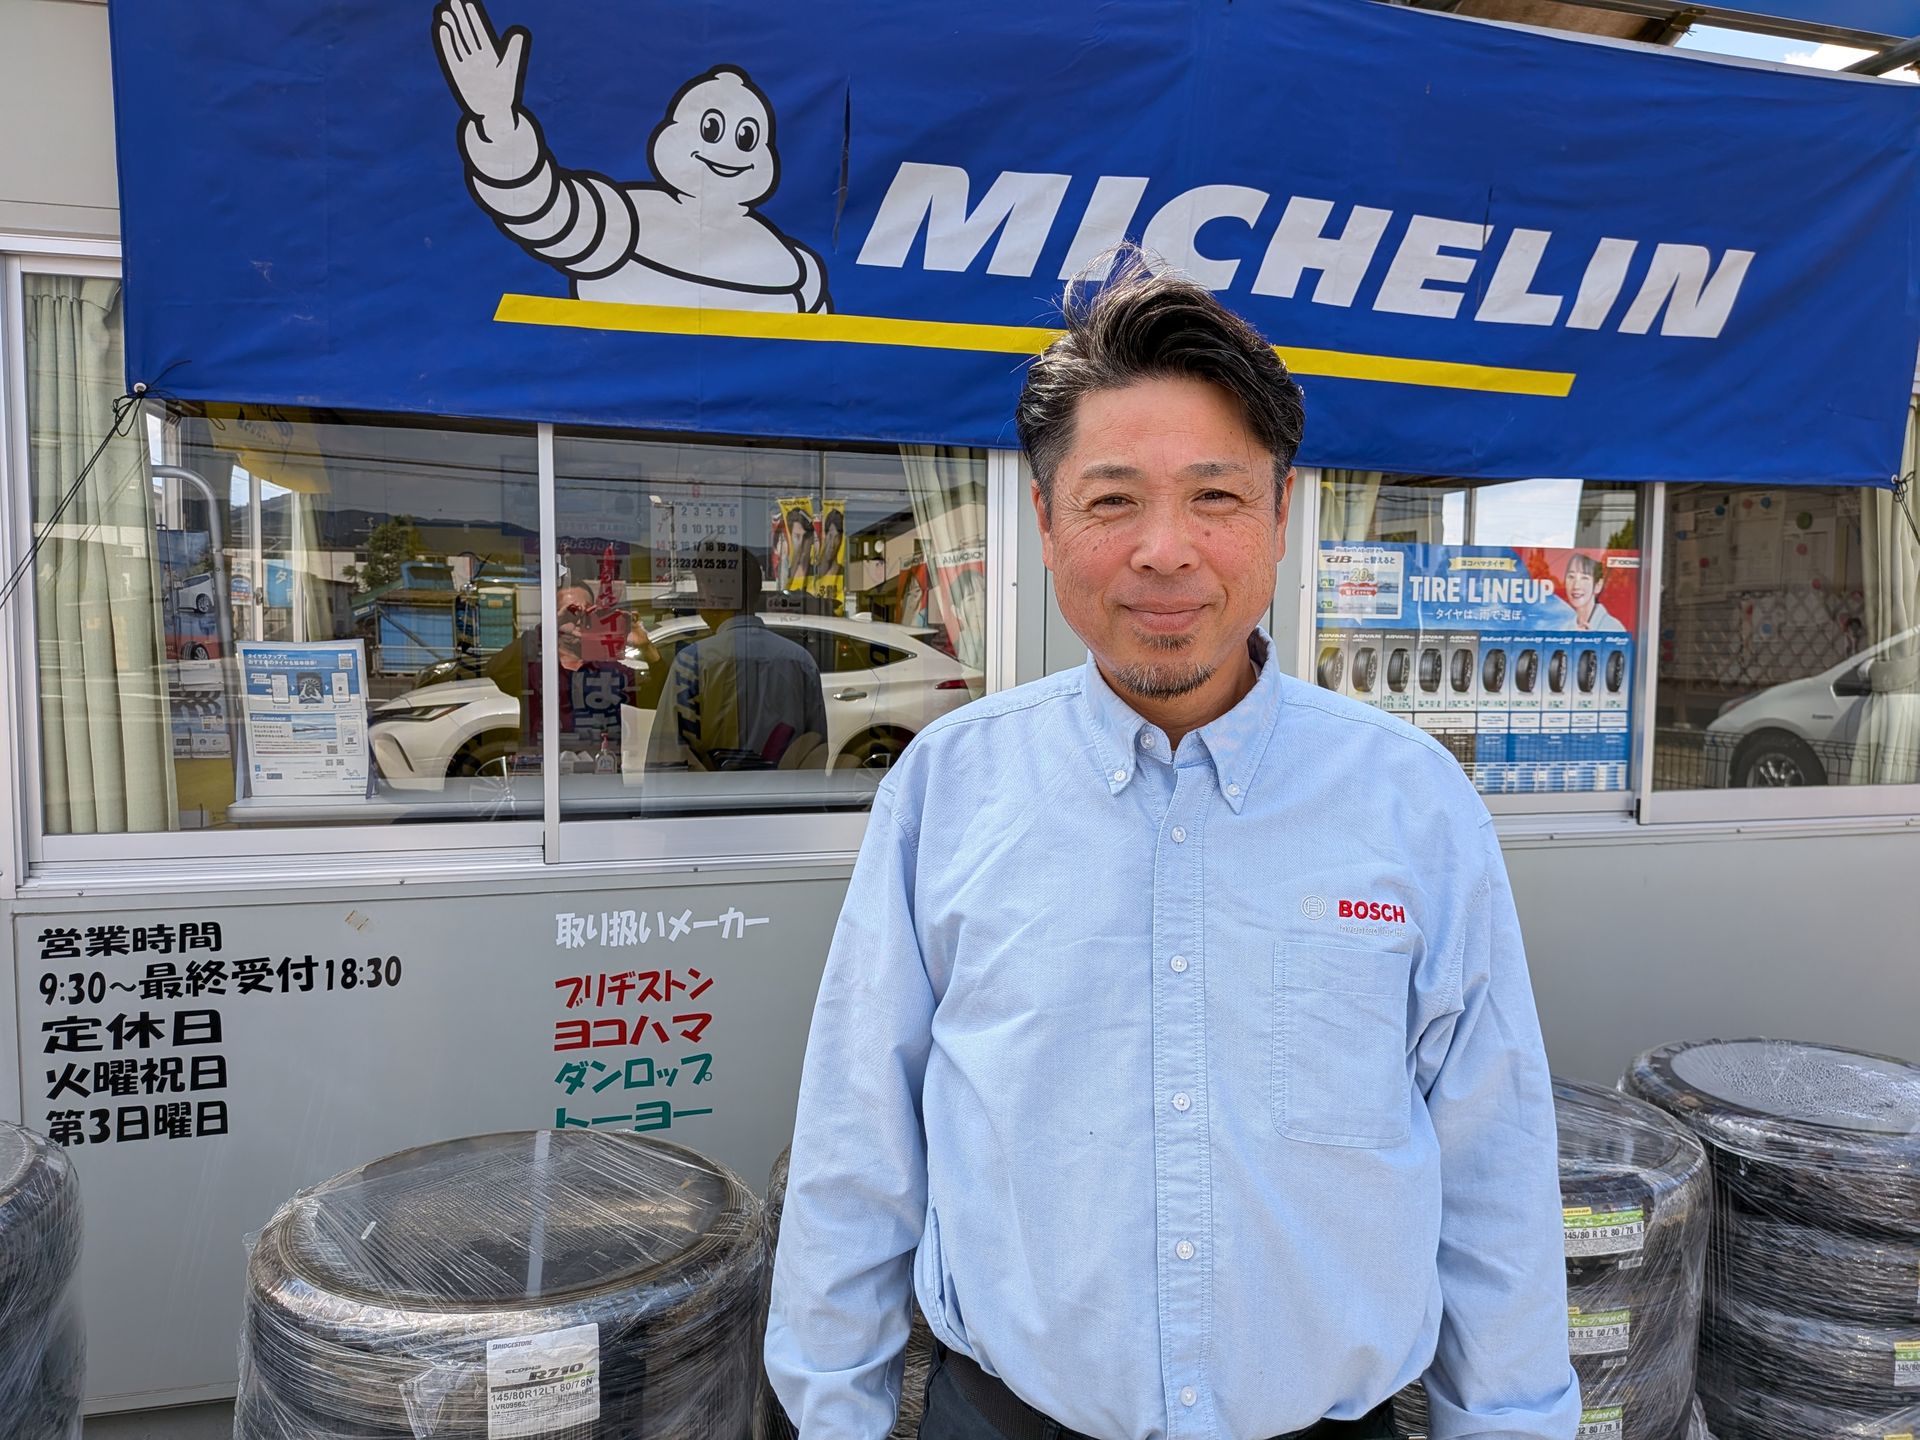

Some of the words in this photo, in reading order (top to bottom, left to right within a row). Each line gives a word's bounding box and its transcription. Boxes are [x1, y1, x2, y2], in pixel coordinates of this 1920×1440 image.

[856, 161, 1755, 338] MICHELIN
[680, 559, 690, 569] 23
[692, 559, 702, 569] 24
[704, 559, 714, 569] 25
[716, 559, 726, 569] 26
[728, 559, 738, 569] 27
[705, 542, 714, 552] 18
[717, 542, 726, 552] 19
[1409, 576, 1460, 603] TIRE
[1468, 577, 1554, 605] LINEUP
[555, 907, 770, 949] 取り扱いメーカー
[1339, 900, 1406, 924] BOSCH
[38, 921, 223, 960] 営業時間
[554, 967, 714, 1009] ブリヂストン
[42, 1008, 223, 1054] 定休日
[553, 1012, 713, 1052] ヨコハマ
[45, 1054, 228, 1101] 火曜祝日
[554, 1052, 713, 1096] ダンロップ
[45, 1100, 229, 1148] 第3日曜日
[555, 1100, 713, 1132] トーヨー
[492, 1340, 533, 1350] BRIDGESTONE
[491, 1385, 557, 1403] 145/80R12LT
[559, 1376, 593, 1392] 80/78N
[529, 1362, 584, 1381] R710
